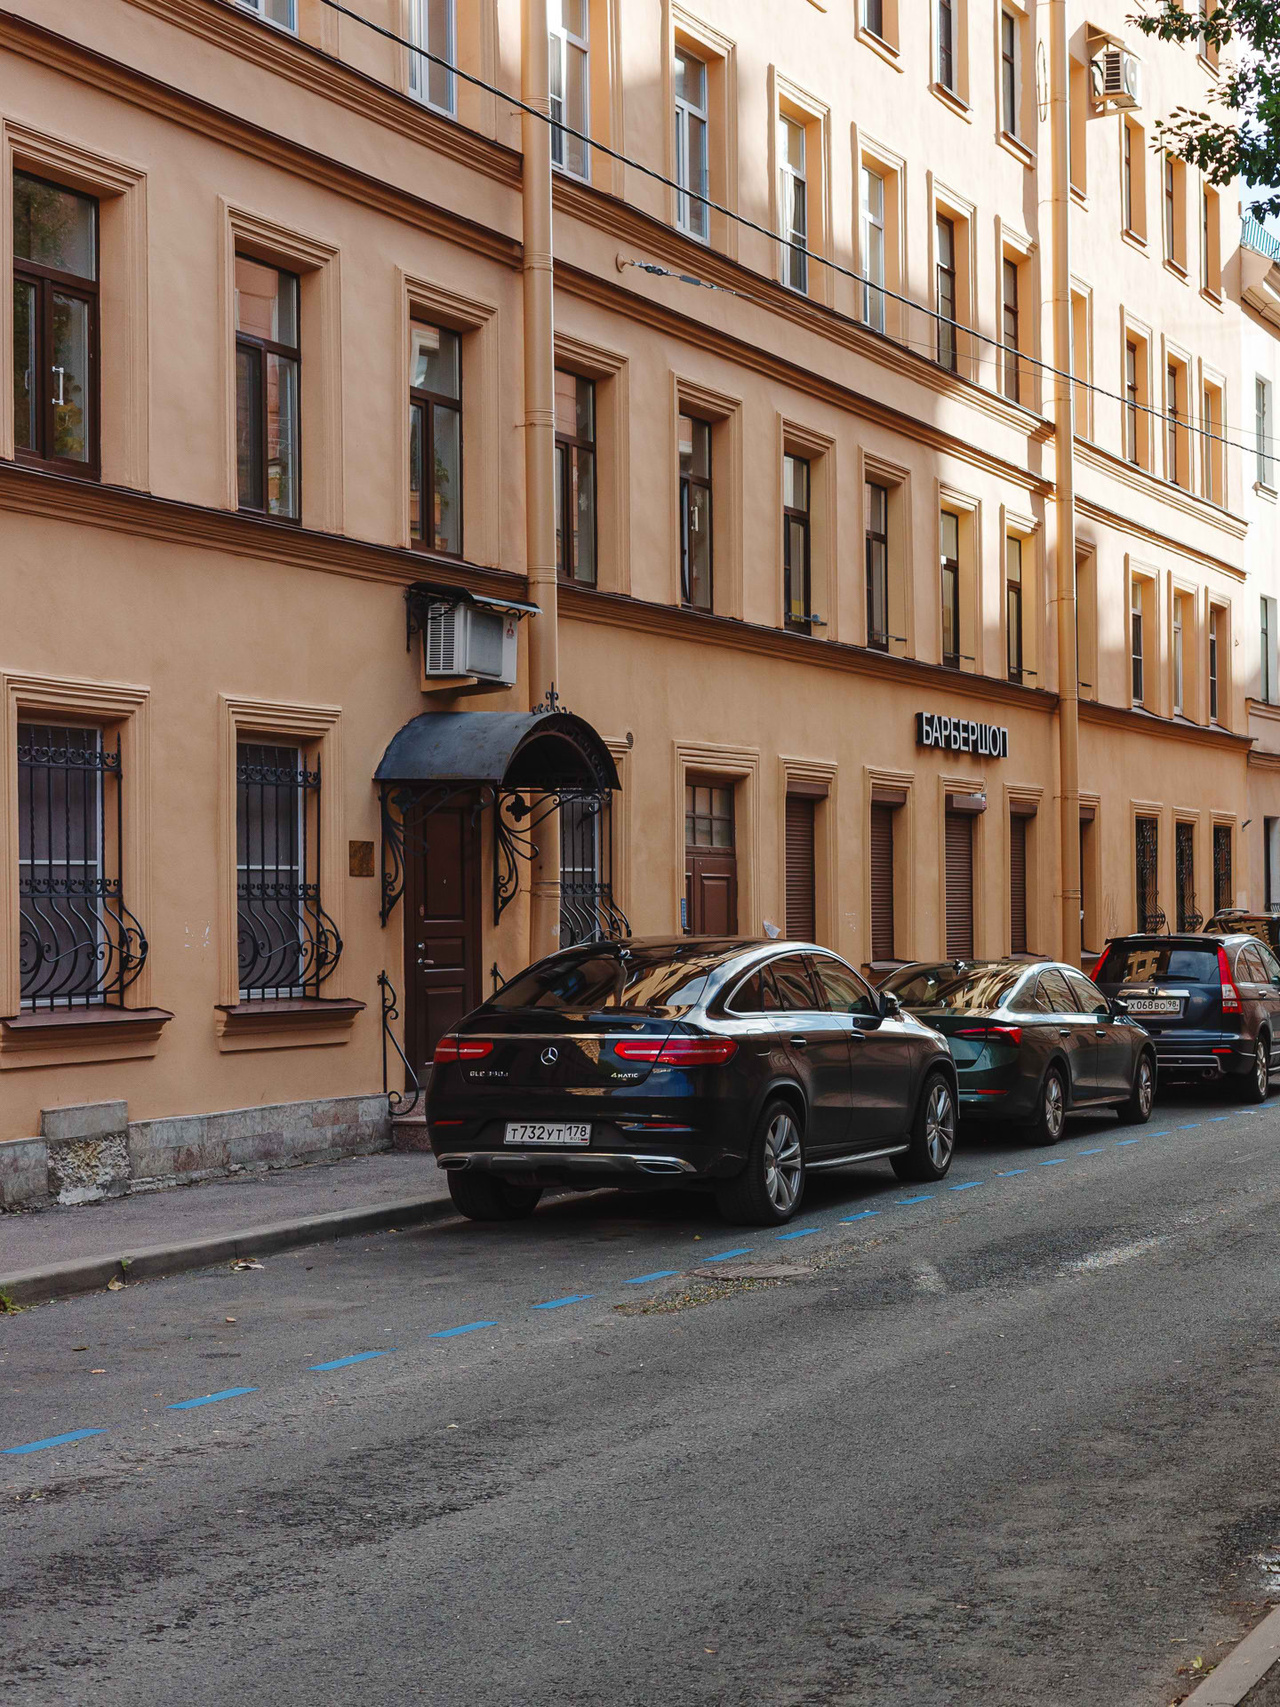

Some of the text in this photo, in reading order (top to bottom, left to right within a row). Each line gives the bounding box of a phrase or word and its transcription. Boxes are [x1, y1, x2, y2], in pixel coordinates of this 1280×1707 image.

[922, 711, 1008, 758] БАРБЕРШОП
[511, 1125, 587, 1140] Т732УТ 178
